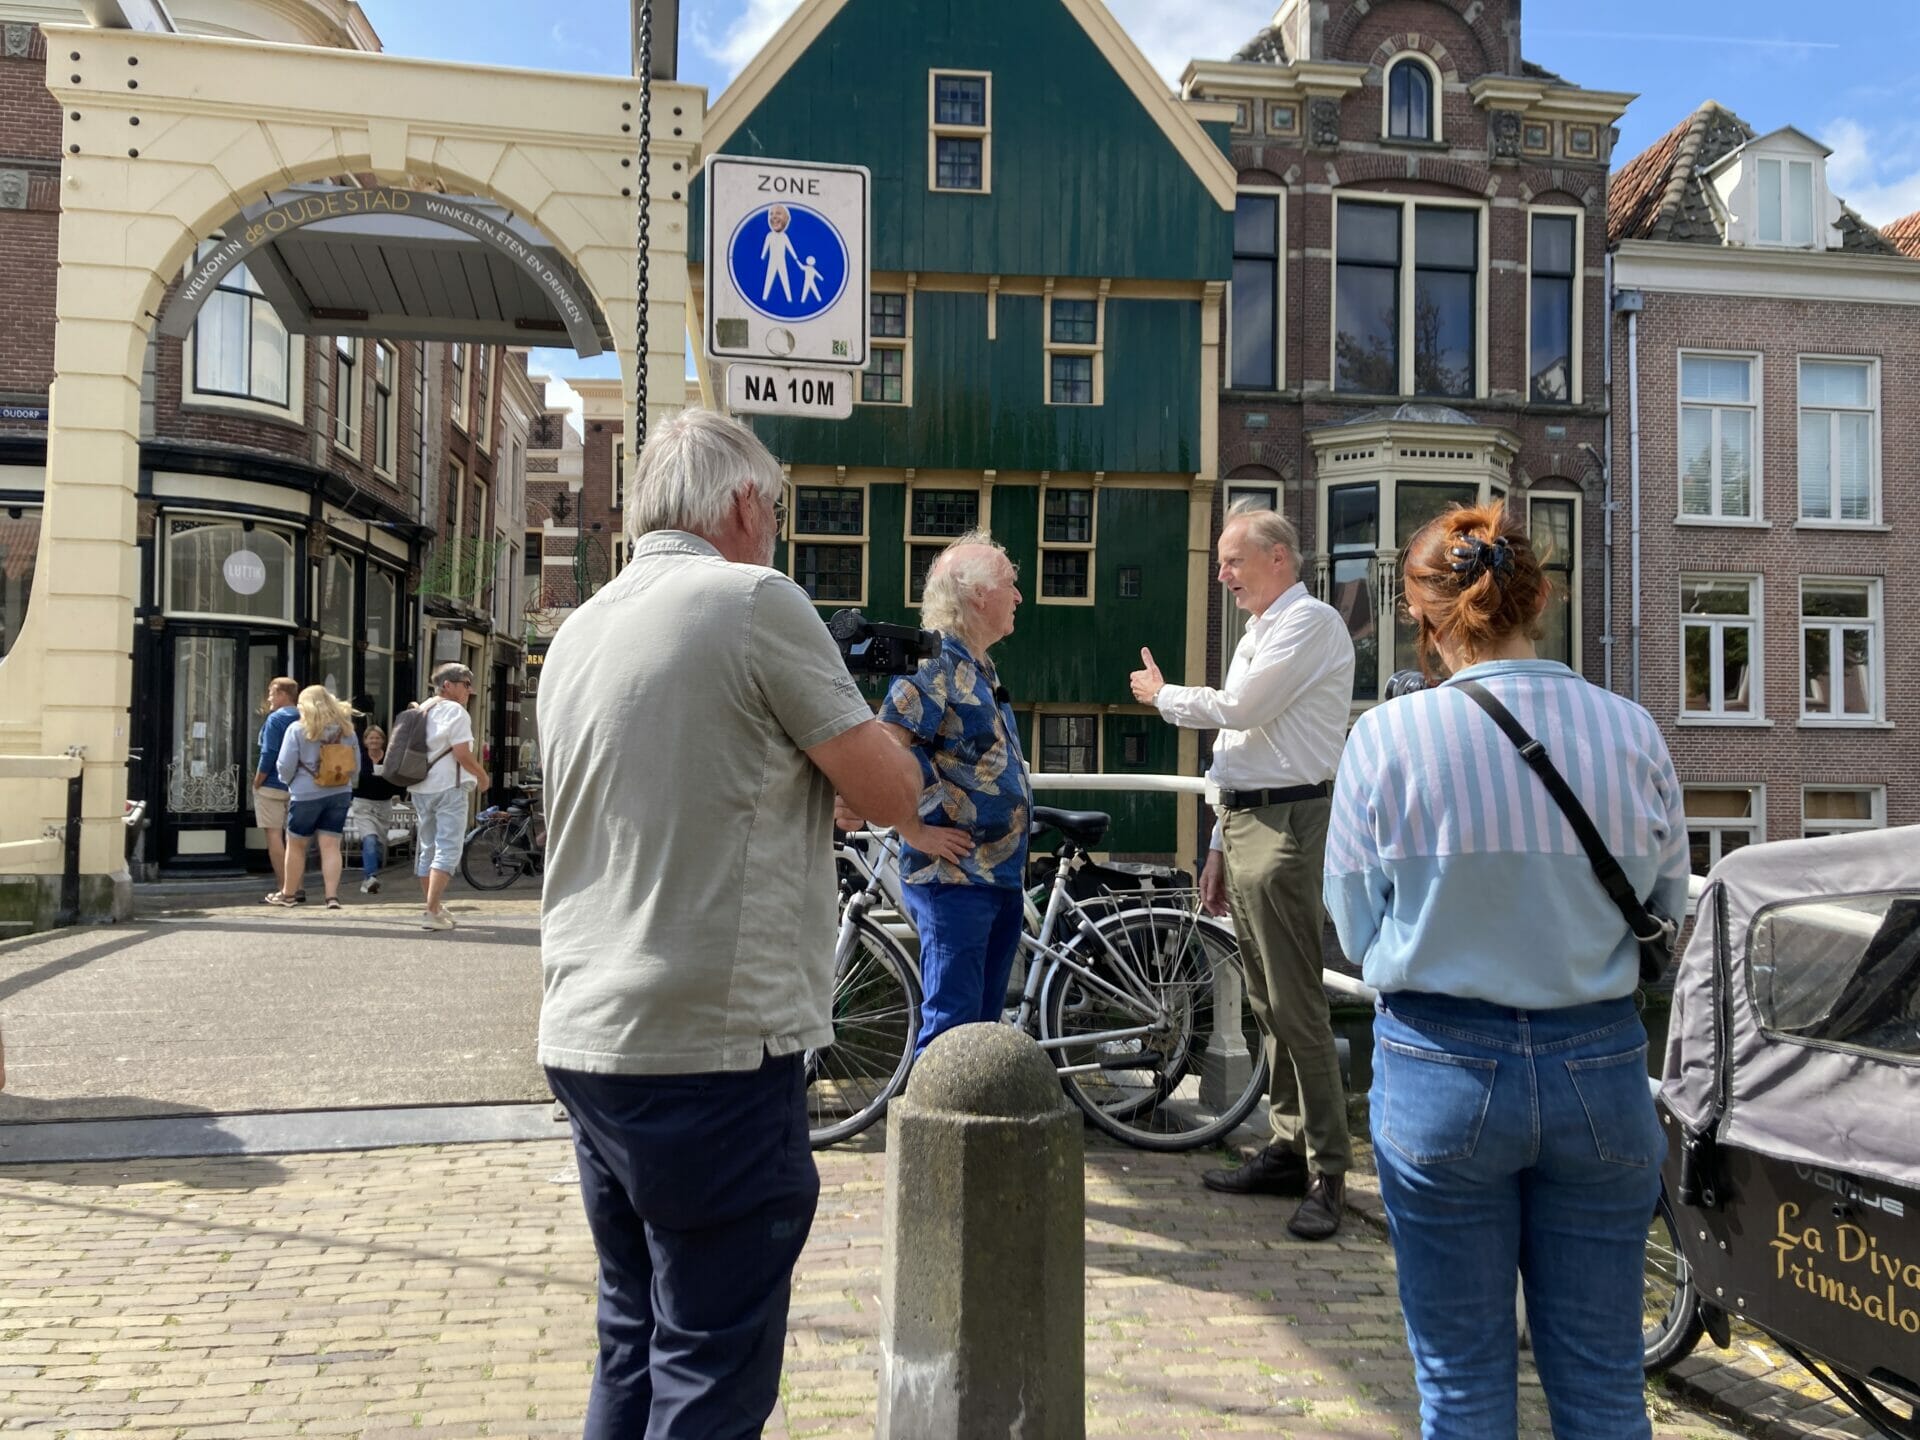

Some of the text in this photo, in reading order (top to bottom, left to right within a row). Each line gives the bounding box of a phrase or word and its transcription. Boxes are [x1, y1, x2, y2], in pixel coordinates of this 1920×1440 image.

[757, 174, 820, 196] ZONE
[182, 252, 227, 300] WELKOM
[224, 239, 243, 256] IN
[245, 222, 265, 243] de
[264, 193, 342, 232] OUDE
[345, 190, 410, 211] STAD
[496, 231, 527, 258] ETEN
[526, 254, 544, 273] EN
[542, 270, 583, 324] DRINKEN
[744, 375, 834, 406] NA 10M
[2, 409, 40, 418] OUDORP
[526, 654, 543, 664] REN
[1777, 1201, 1920, 1291] La Diva
[1768, 1239, 1920, 1333] Trimsalo
